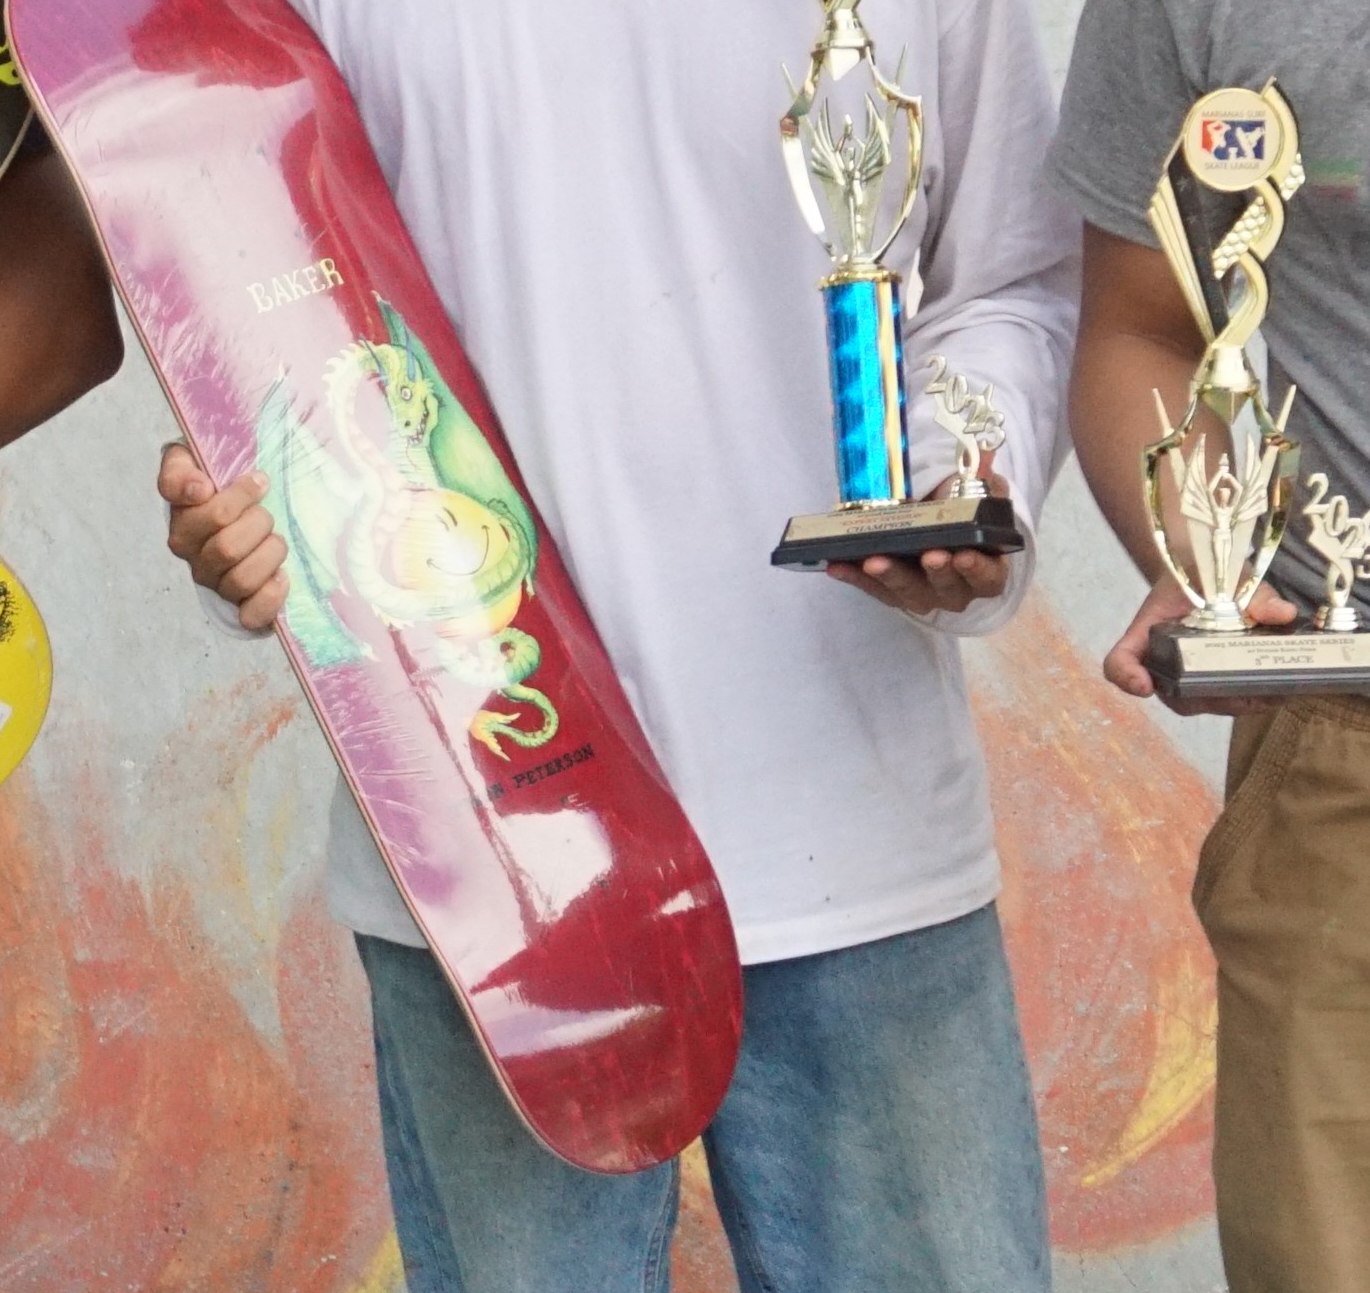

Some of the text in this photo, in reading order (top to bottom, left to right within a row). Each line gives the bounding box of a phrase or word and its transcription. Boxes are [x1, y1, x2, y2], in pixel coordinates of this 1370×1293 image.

[246, 258, 345, 314] BAKER
[1228, 639, 1282, 648] MARIANAS
[1319, 637, 1356, 645] SERIES
[1272, 655, 1315, 665] PLACE
[512, 743, 595, 789] PETERSON
